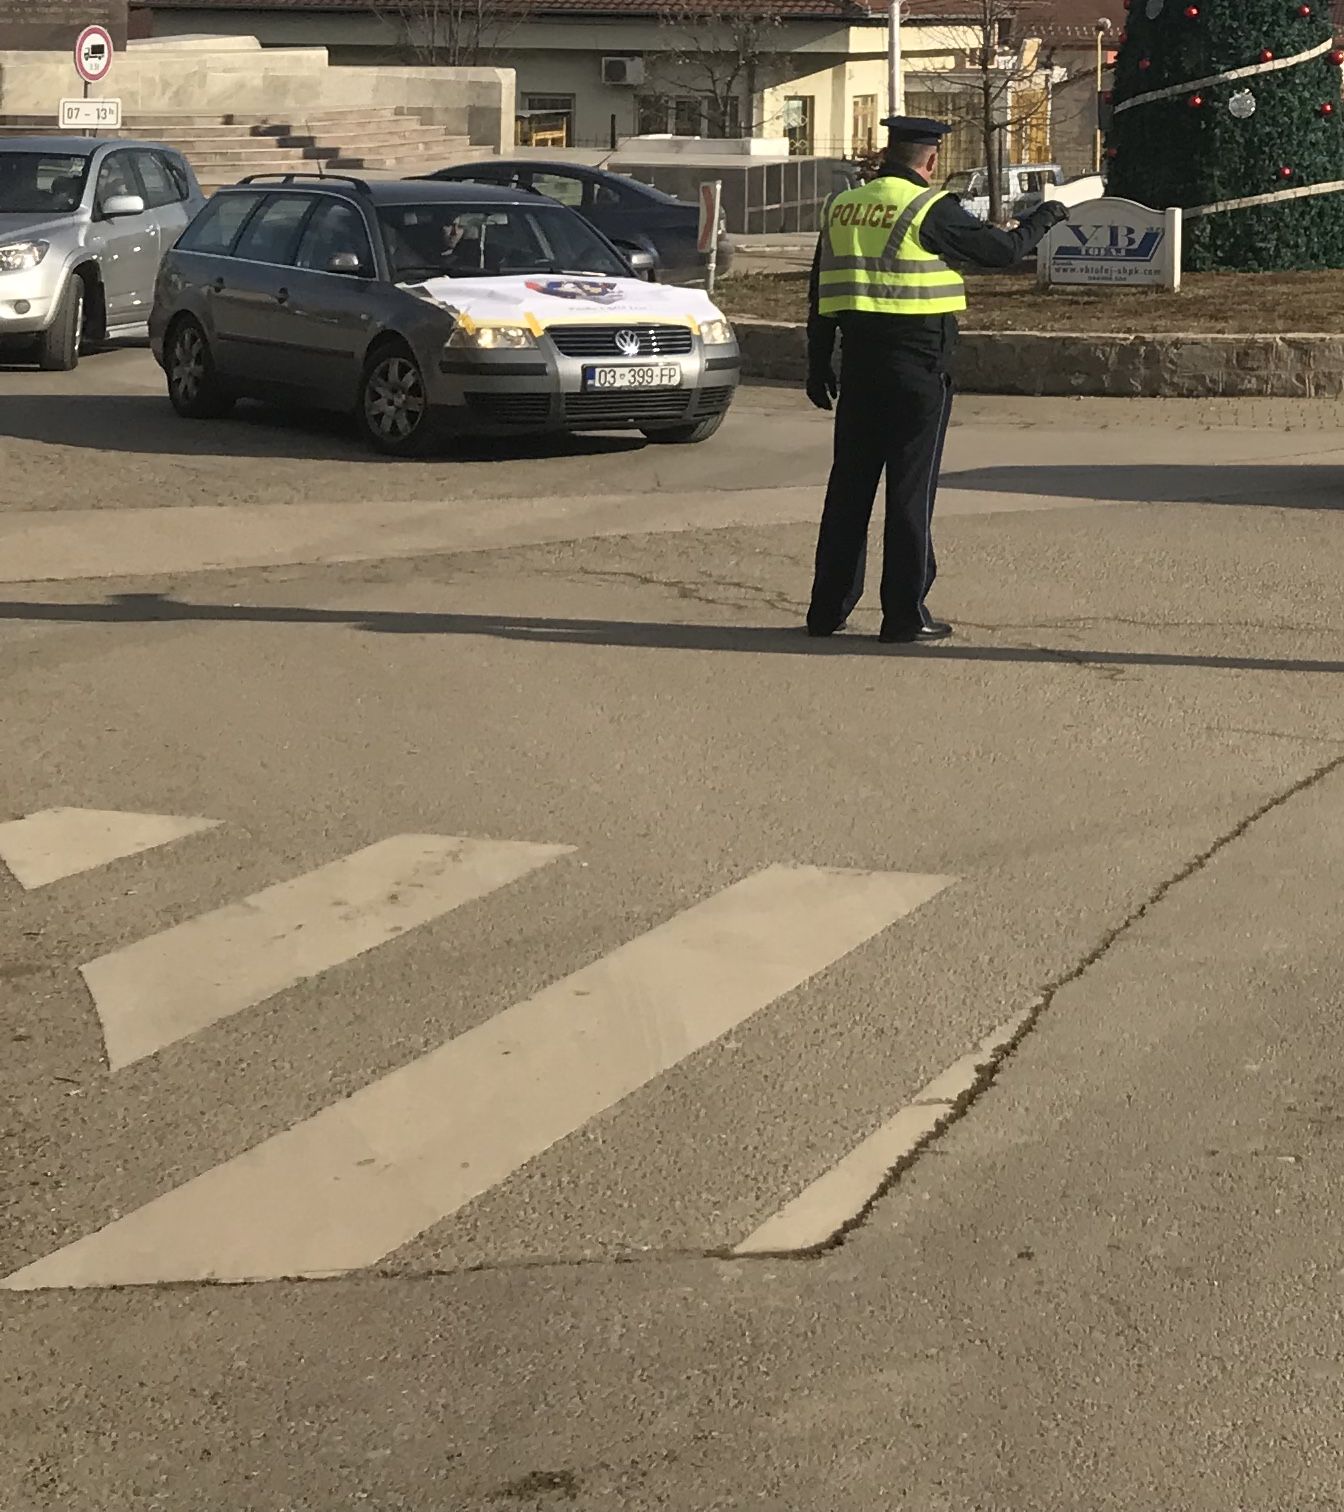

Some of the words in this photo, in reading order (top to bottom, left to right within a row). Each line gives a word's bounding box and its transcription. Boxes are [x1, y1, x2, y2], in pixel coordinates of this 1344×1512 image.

[67, 107, 80, 119] 07
[830, 203, 898, 229] POLICE
[1066, 224, 1137, 248] VB
[597, 368, 616, 387] 03
